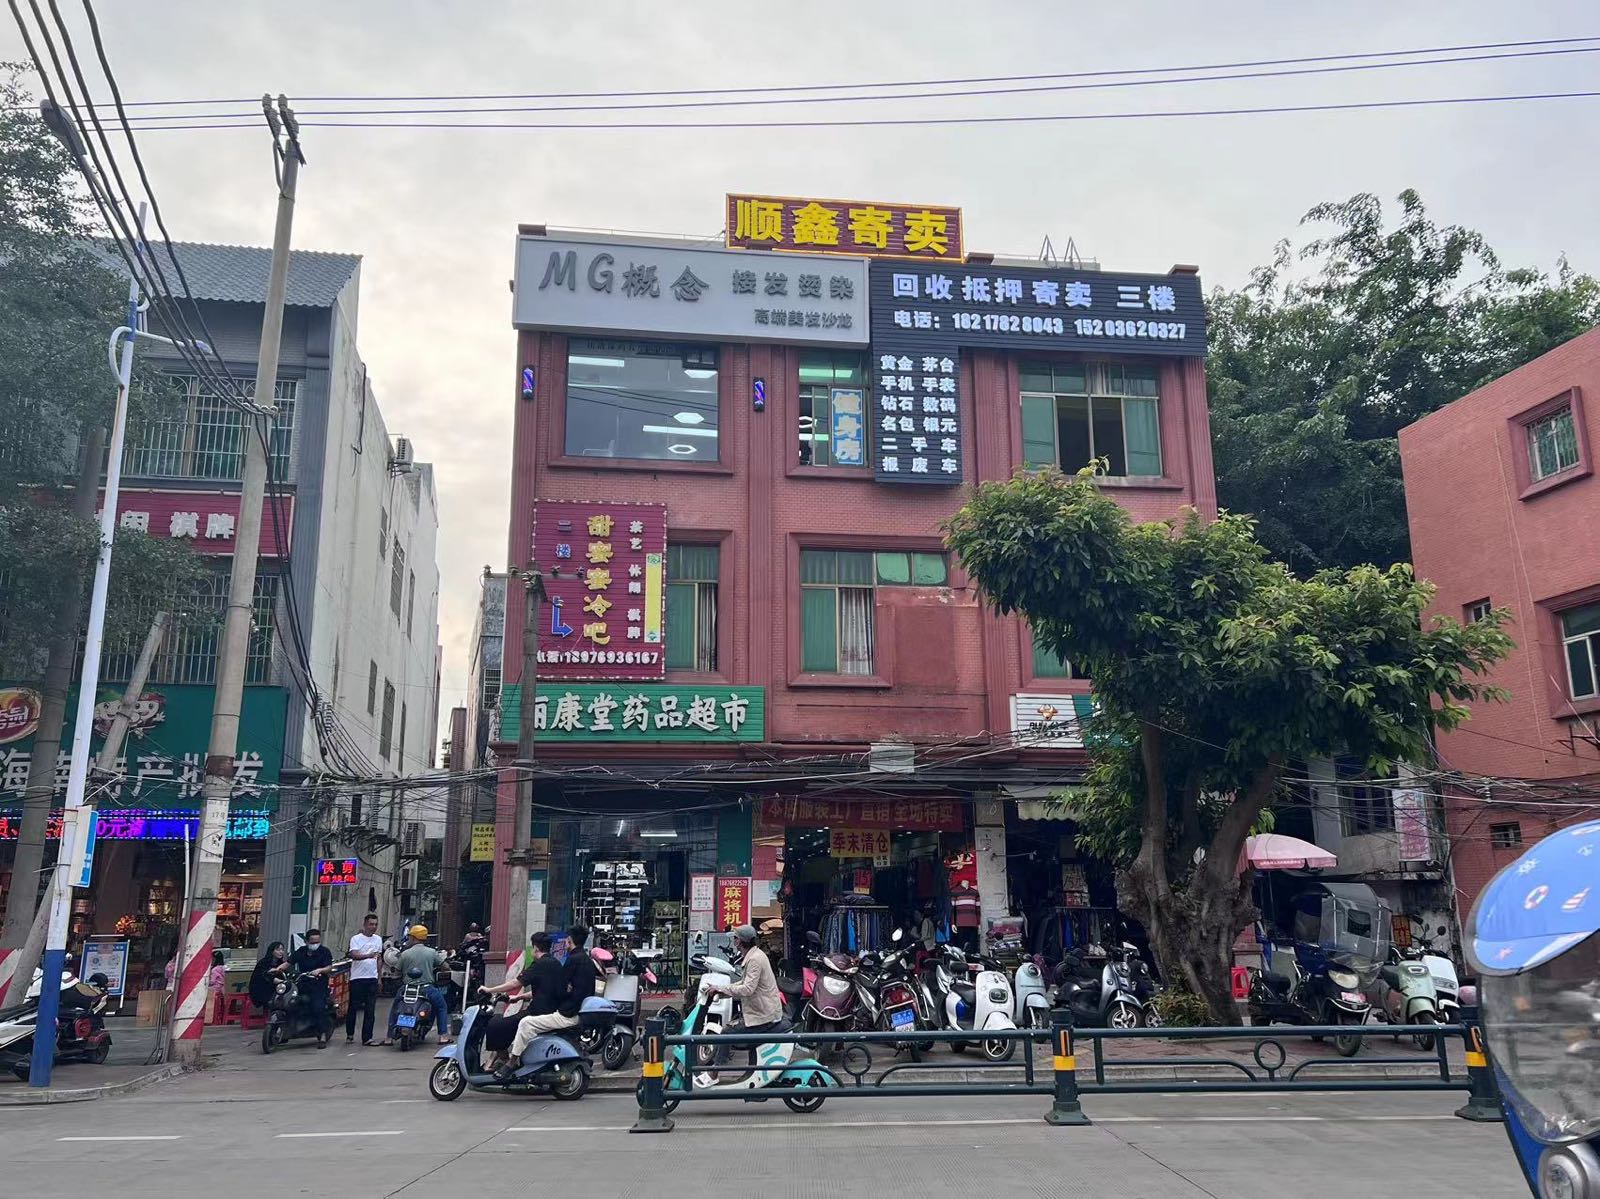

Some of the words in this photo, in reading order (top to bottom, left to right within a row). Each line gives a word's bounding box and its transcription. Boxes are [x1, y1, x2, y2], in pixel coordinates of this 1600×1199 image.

[734, 199, 949, 255] 顺鑫寄卖
[732, 269, 855, 300] 接发烫染
[1116, 285, 1176, 312] 三楼
[754, 307, 853, 329] 高端美发沙龙
[880, 355, 914, 372] 黄金
[922, 356, 955, 373] 茅台
[881, 375, 915, 392] 手机
[922, 377, 956, 393] 手表
[881, 395, 914, 412] 钻石
[923, 396, 956, 413] 数码
[881, 415, 915, 432] 名包
[923, 416, 957, 433] 银元
[833, 832, 889, 856] 季末清仓
[723, 887, 743, 925] 麻将机
